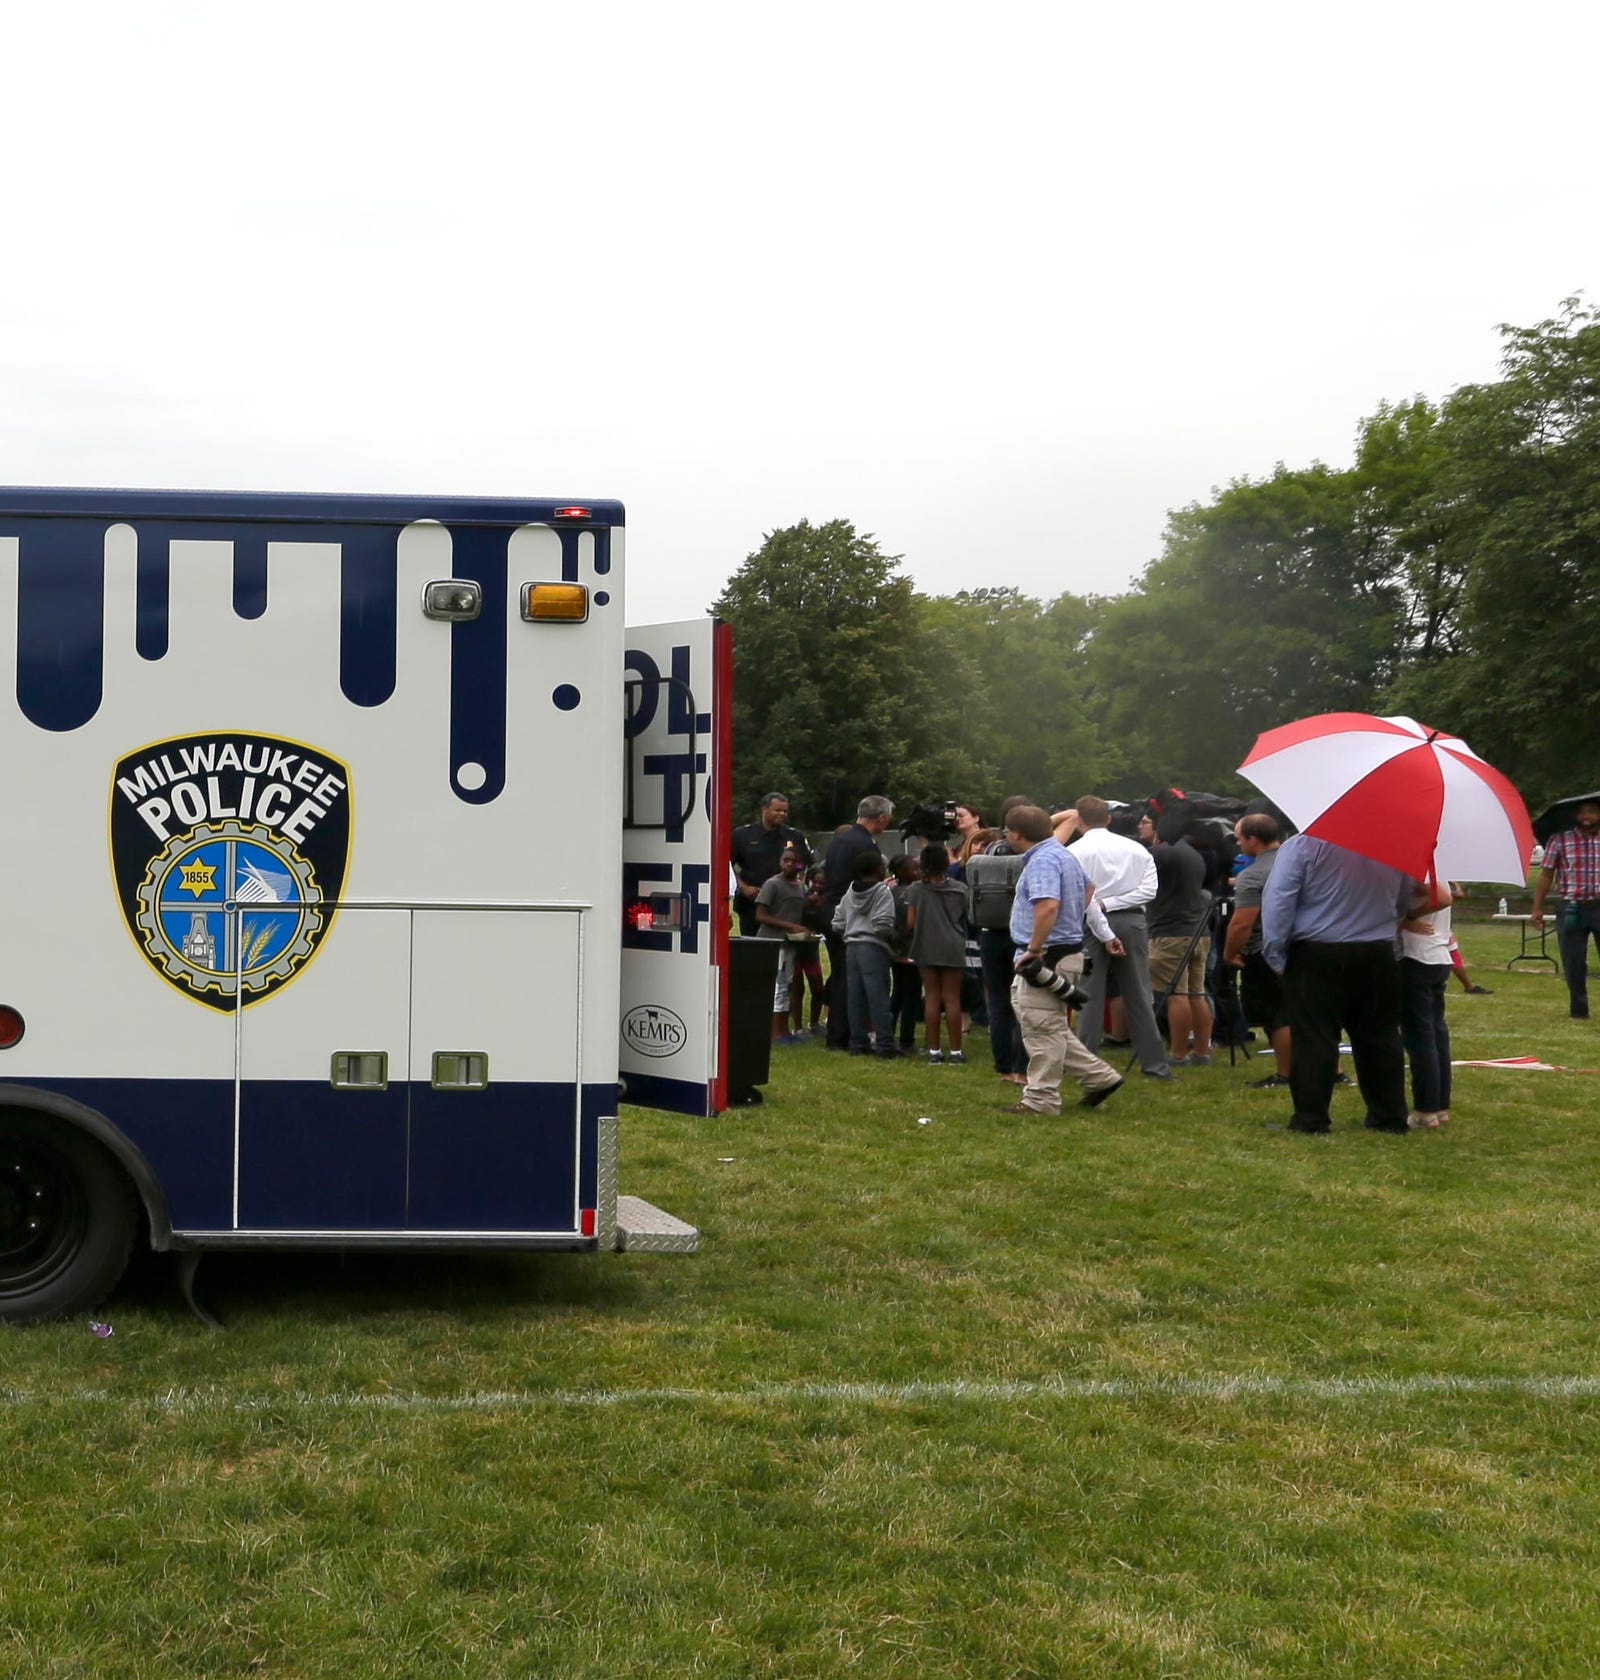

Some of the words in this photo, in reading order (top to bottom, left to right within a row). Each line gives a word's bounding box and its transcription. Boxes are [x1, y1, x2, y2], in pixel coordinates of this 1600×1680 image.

[117, 743, 346, 806] MILWAUKEE
[643, 753, 712, 843] T
[137, 776, 327, 844] POLICE
[184, 871, 210, 884] 1855
[627, 1019, 681, 1043] KEMPS
